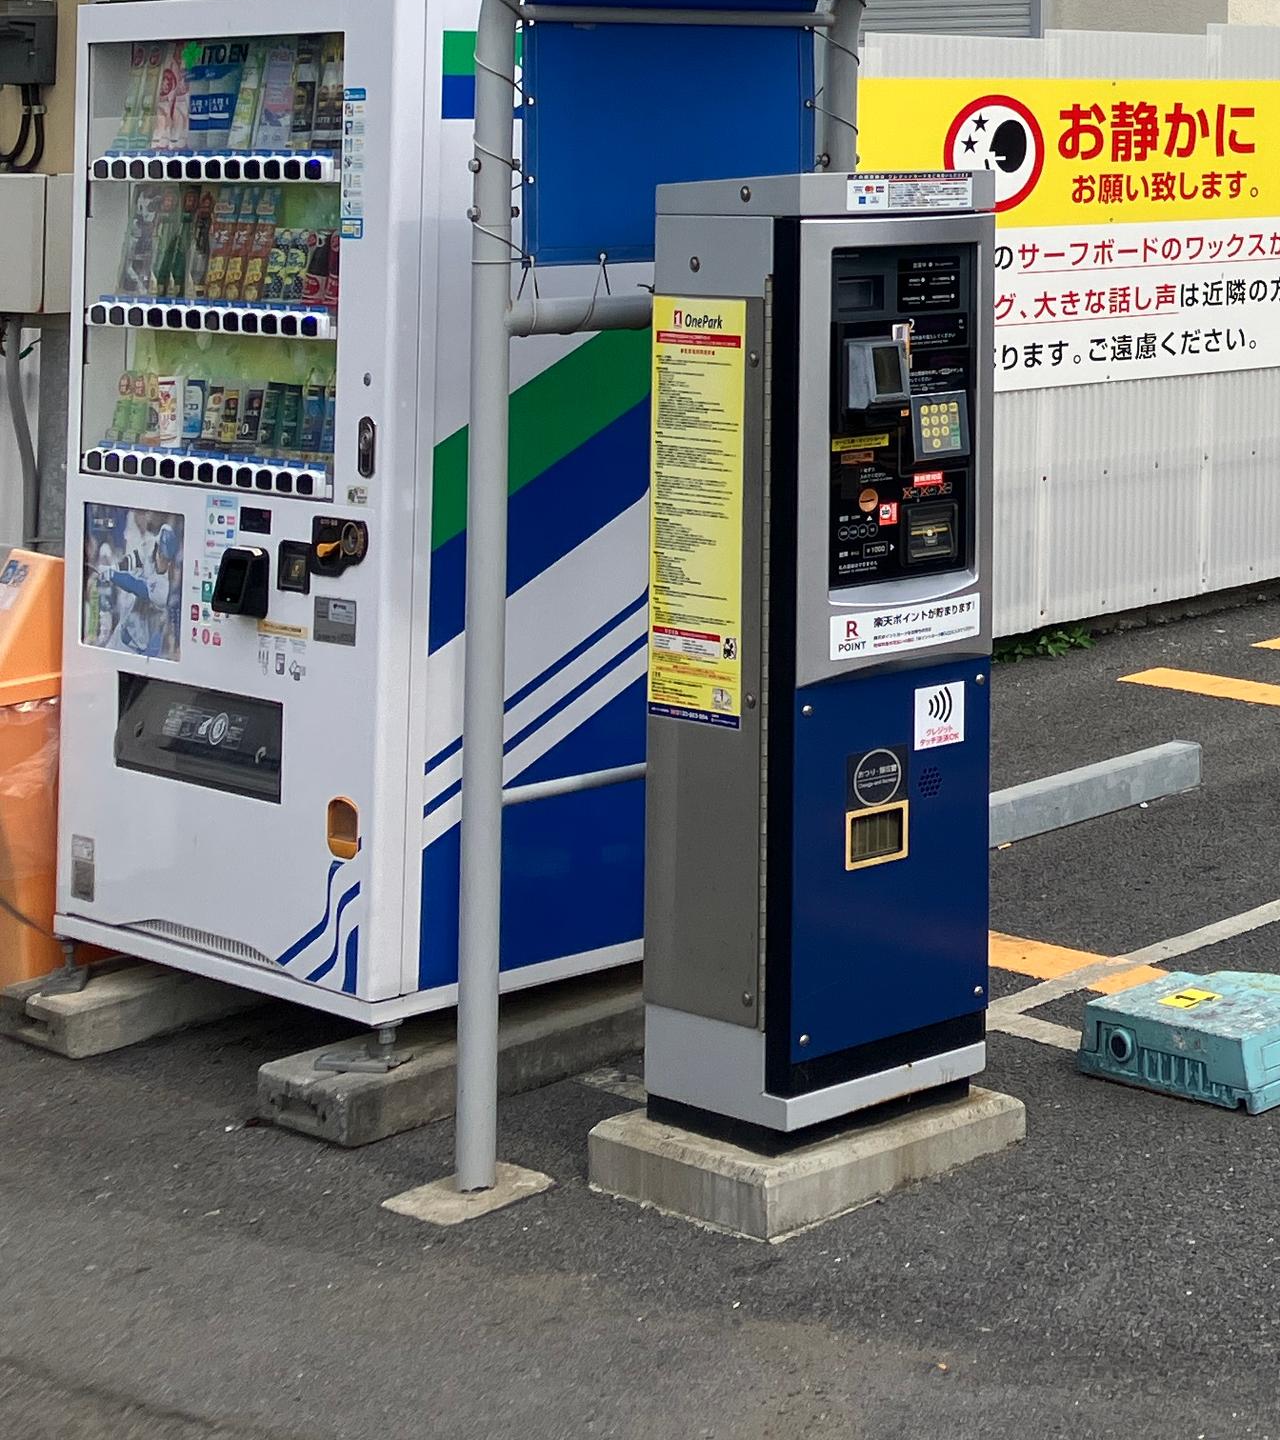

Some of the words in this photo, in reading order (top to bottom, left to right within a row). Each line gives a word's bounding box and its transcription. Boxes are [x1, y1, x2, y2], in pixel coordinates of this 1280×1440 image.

[201, 44, 228, 65] ITO
[229, 42, 250, 63] EN
[1058, 101, 1256, 163] お静かに
[1071, 170, 1260, 205] お願い致します。
[684, 313, 723, 329] OnePark
[993, 328, 1258, 372] ります。ご遠慮ください。
[838, 641, 866, 652] POINT
[926, 725, 953, 736] クレジット
